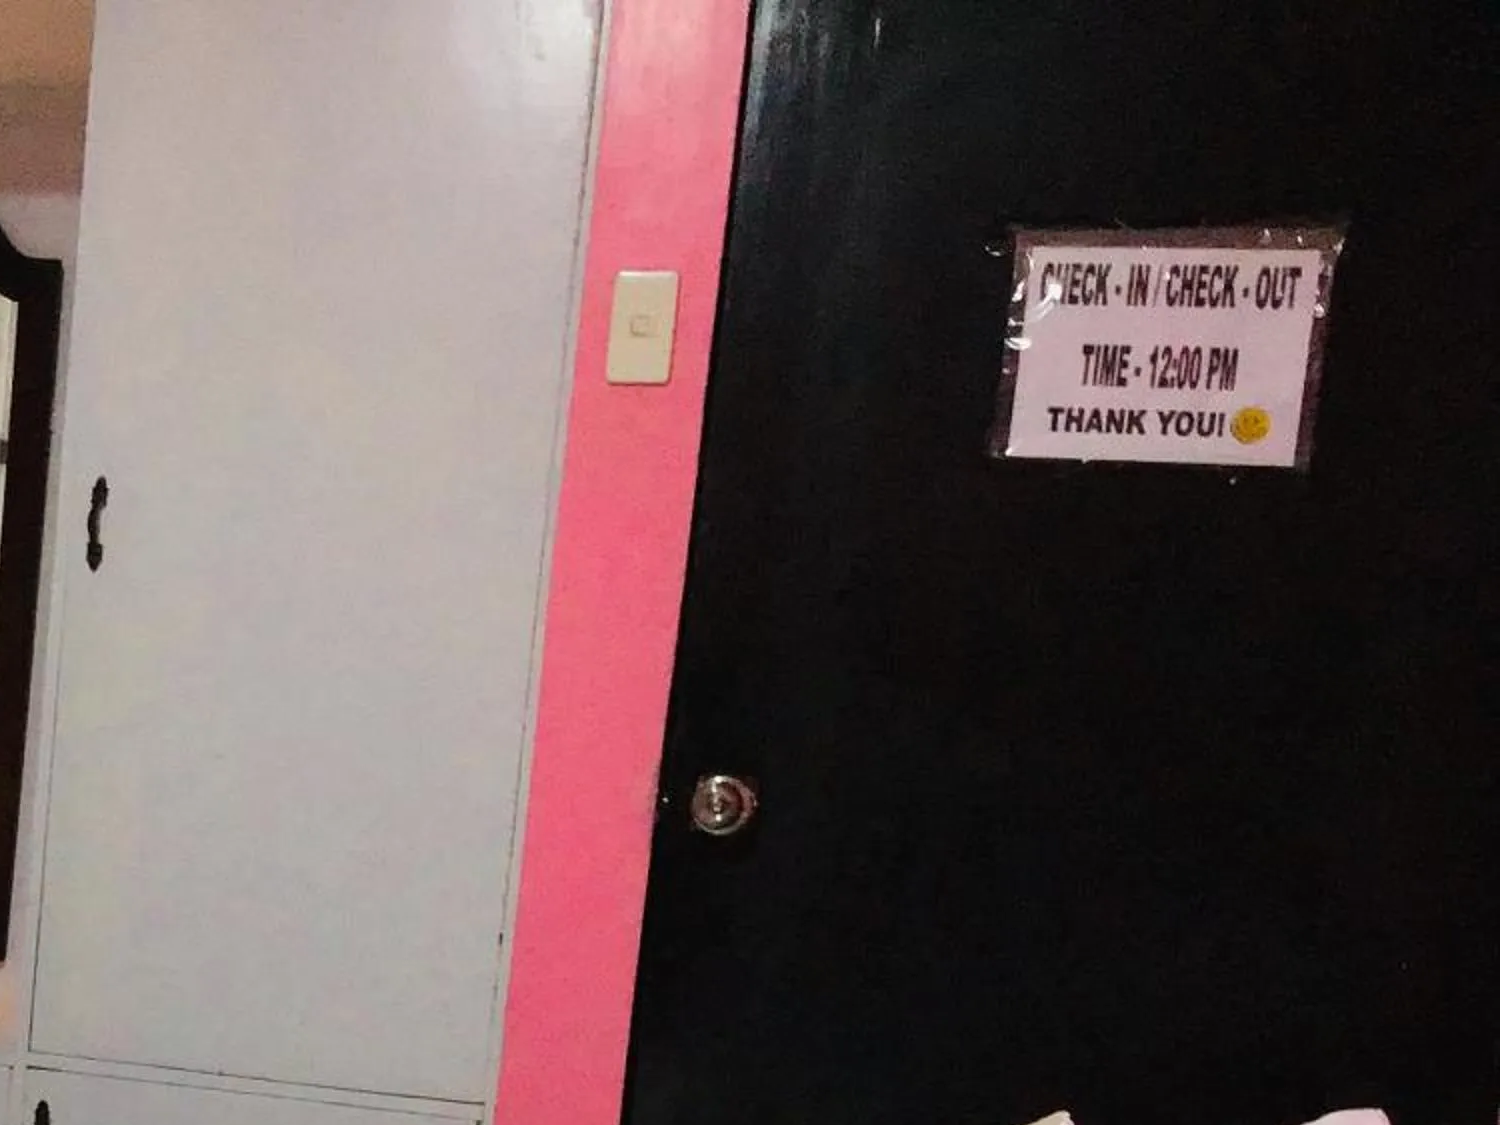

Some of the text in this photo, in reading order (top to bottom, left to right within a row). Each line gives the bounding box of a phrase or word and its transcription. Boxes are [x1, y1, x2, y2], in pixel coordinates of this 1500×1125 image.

[1126, 263, 1151, 307] IN
[1166, 264, 1239, 307] CHECK
[1255, 266, 1302, 310] OUT
[1081, 343, 1132, 387] TIME
[1150, 345, 1202, 390] 12:00
[1205, 347, 1239, 391] PM
[1047, 407, 1226, 437] THANK YOU!
